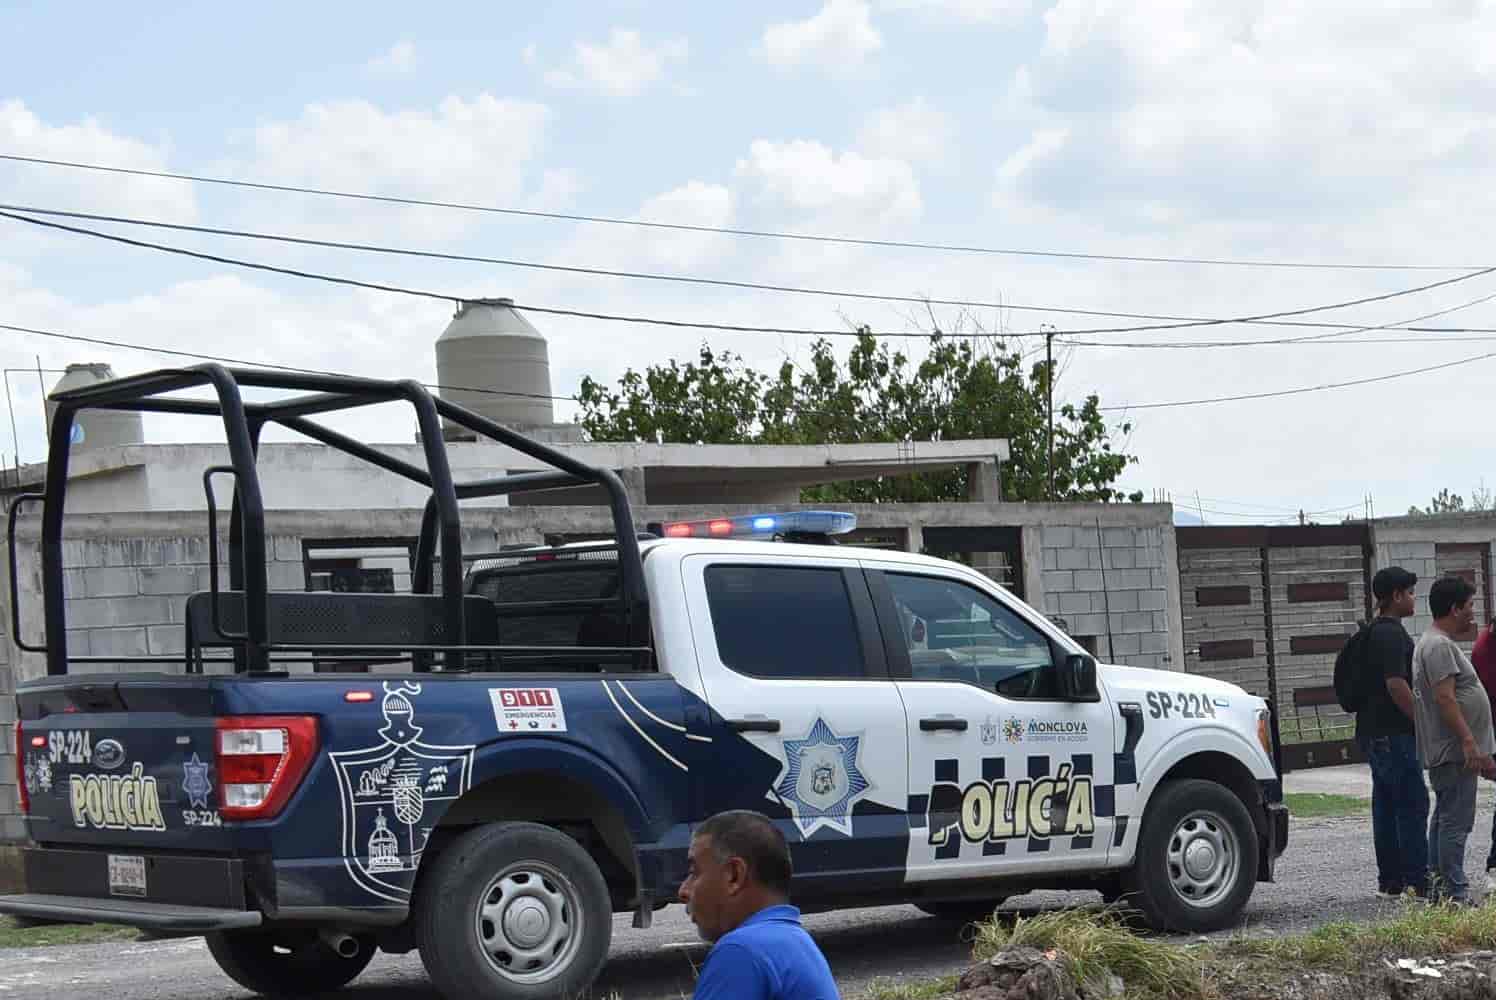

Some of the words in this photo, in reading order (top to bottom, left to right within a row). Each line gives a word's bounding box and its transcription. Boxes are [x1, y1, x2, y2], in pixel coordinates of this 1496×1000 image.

[503, 690, 549, 706] 911
[1146, 691, 1216, 719] SP-224
[1028, 720, 1088, 732] MONCLOVA
[49, 730, 92, 763] SP-224
[69, 761, 166, 832] POLICÍA
[182, 810, 222, 827] SP-224
